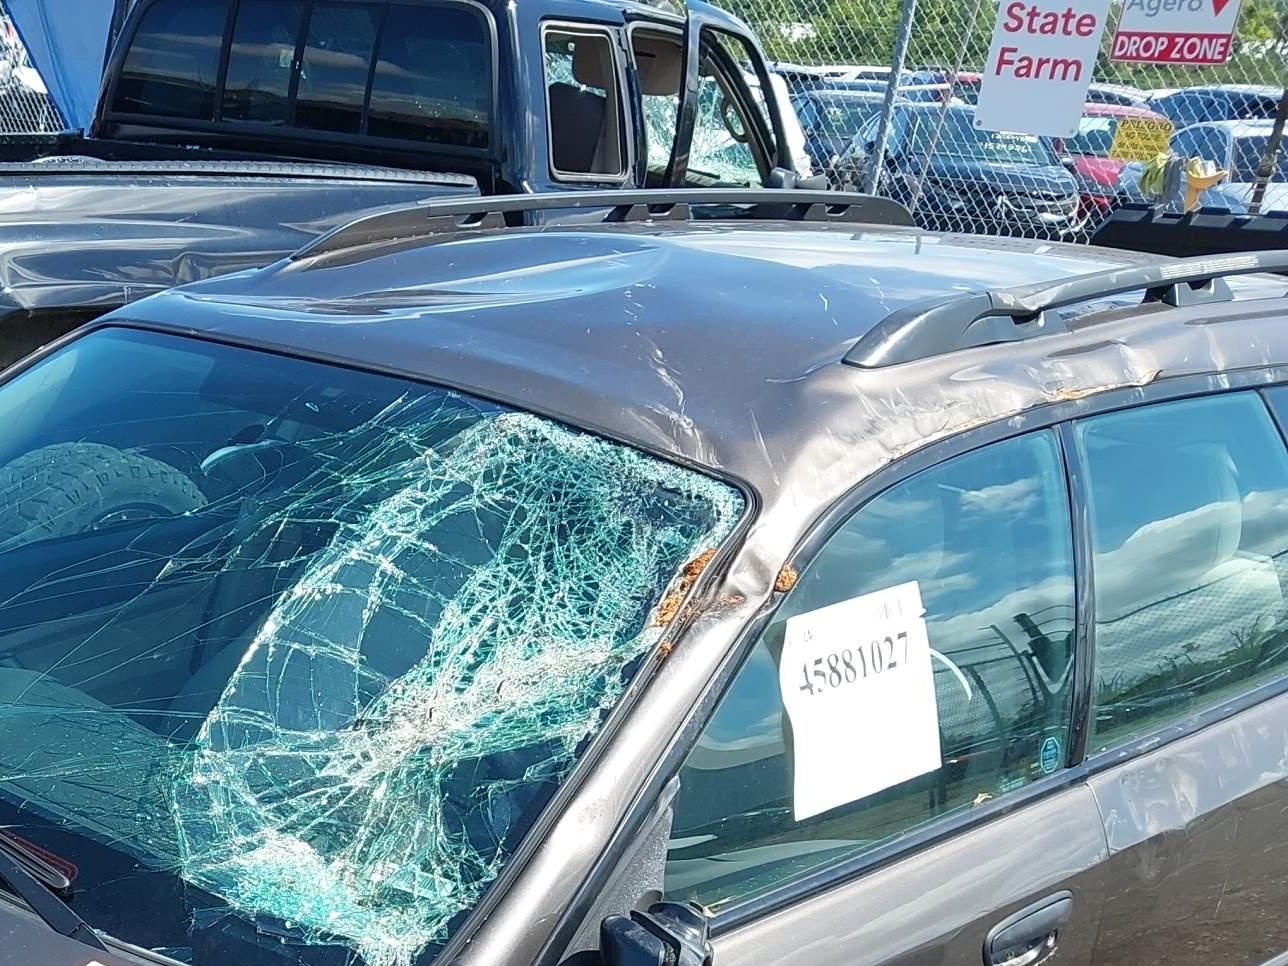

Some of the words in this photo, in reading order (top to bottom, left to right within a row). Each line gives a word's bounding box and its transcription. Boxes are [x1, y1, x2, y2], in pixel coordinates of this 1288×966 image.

[1003, 2, 1097, 37] State
[1126, 0, 1203, 17] Agero
[995, 46, 1082, 82] Farm
[1114, 35, 1168, 58] DROP
[1170, 36, 1227, 60] ZONE
[799, 631, 908, 695] 45881027
